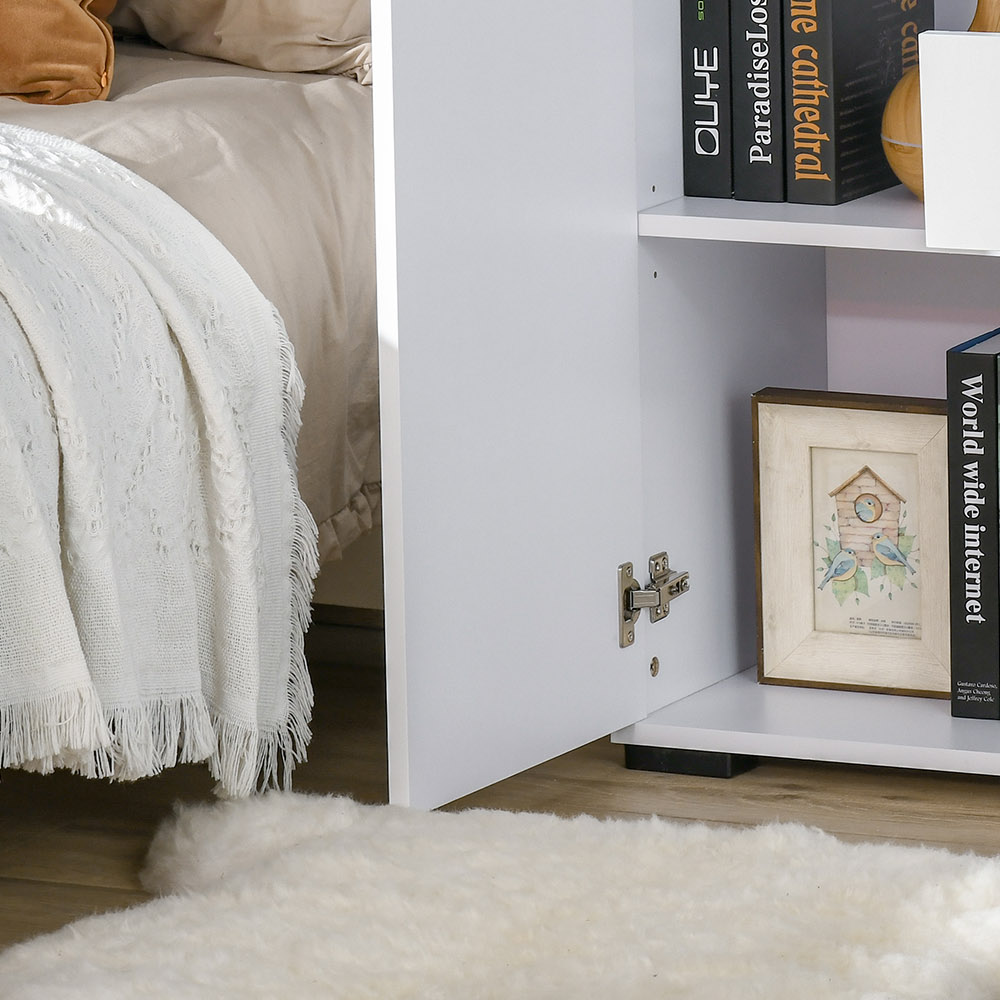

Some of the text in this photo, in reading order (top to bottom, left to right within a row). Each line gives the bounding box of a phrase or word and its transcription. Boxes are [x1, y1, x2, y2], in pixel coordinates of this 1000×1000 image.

[693, 46, 720, 156] OUYE
[791, 44, 832, 182] cathedral
[961, 373, 986, 624] World wide internet
